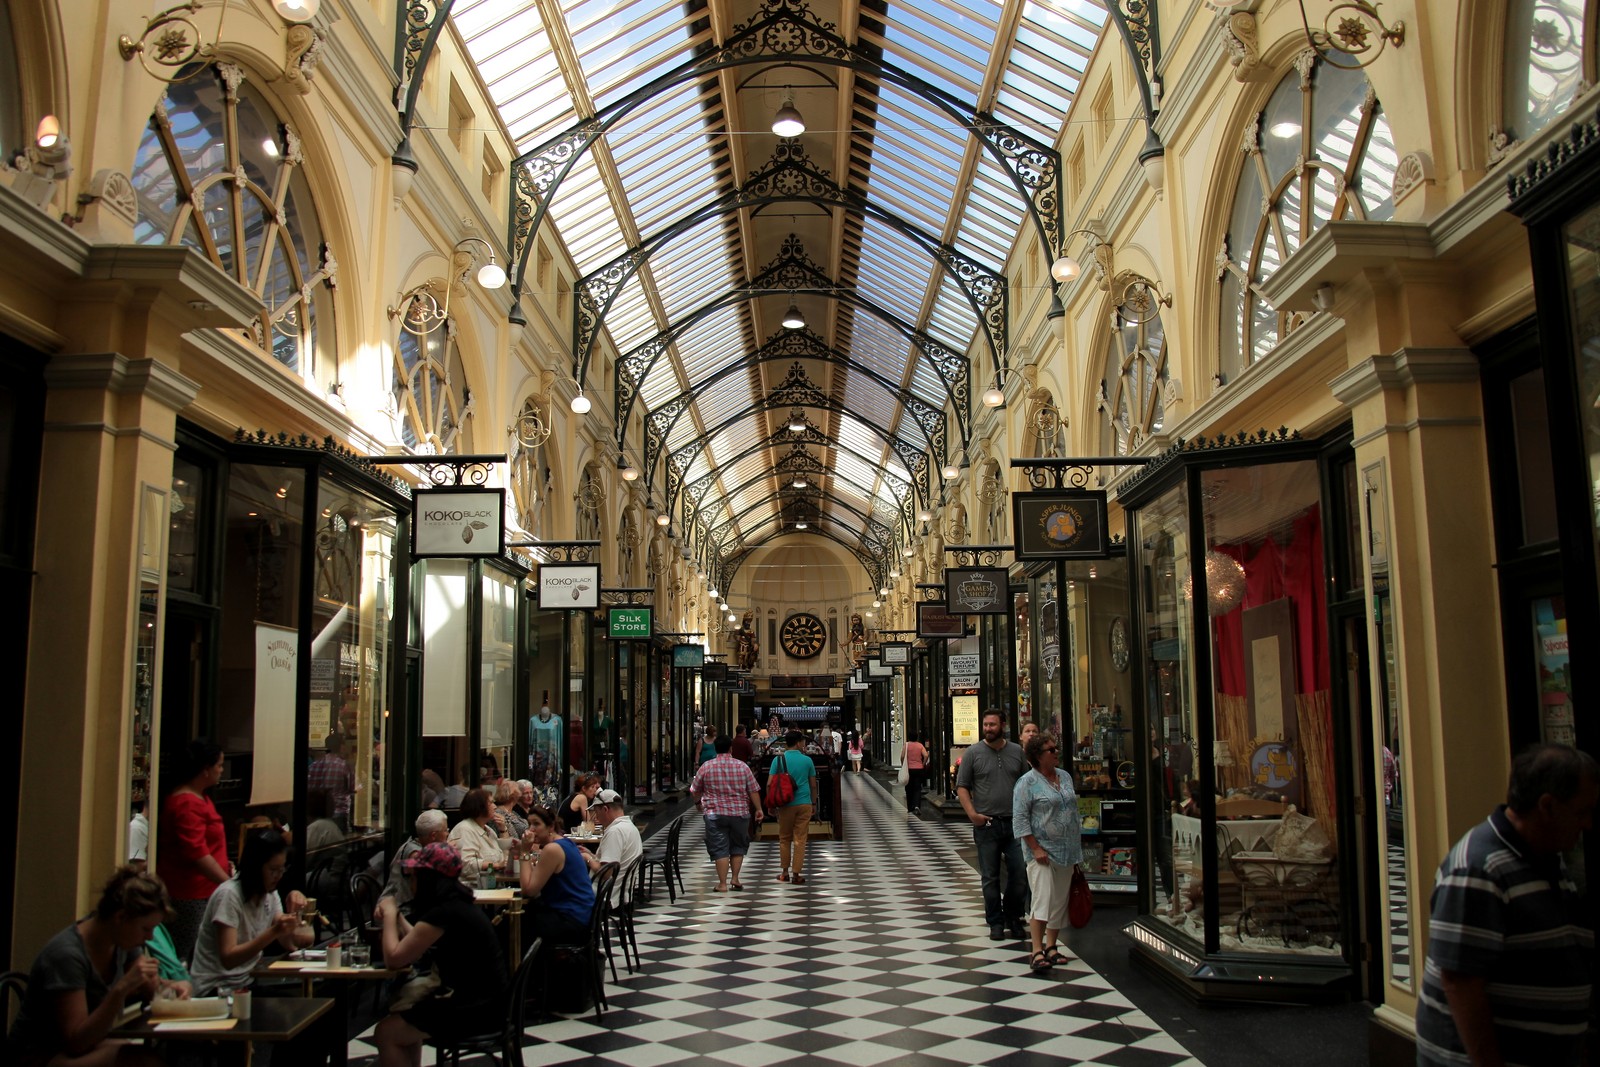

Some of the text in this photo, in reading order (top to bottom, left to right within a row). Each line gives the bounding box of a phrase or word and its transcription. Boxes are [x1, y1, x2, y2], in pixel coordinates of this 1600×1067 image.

[424, 510, 463, 521] KOKO
[1038, 504, 1084, 528] JASPER JUNIOR
[545, 578, 573, 586] KOKO
[613, 623, 647, 631] STORE
[267, 640, 296, 657] Summer
[271, 655, 291, 672] Oasis
